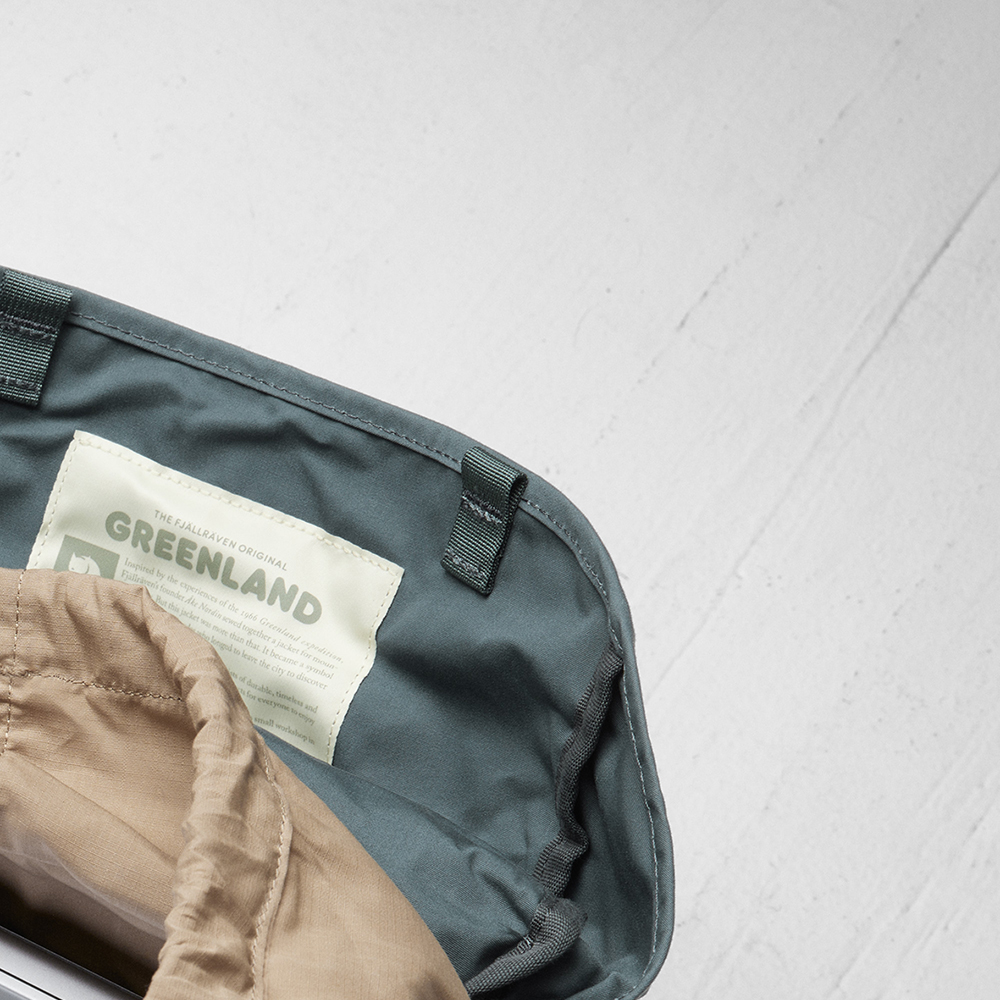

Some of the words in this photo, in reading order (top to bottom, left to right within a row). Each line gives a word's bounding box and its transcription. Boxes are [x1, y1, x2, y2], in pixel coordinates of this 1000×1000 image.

[105, 511, 322, 625] GREENLAND
[154, 509, 173, 525] THE
[175, 518, 237, 549] FJÄLLRÄVEN
[237, 544, 287, 572] ORIGINAL
[124, 558, 154, 575] Inspired
[155, 569, 166, 581] by
[166, 574, 179, 585] the
[179, 579, 218, 604] experiences
[218, 599, 230, 608] of
[227, 602, 240, 614] the
[240, 610, 258, 622] 1966
[259, 617, 302, 642] Greenland
[158, 583, 186, 602] founder
[221, 615, 244, 630] sewed
[241, 624, 272, 642] together
[274, 638, 300, 655] jacket
[299, 649, 313, 660] for
[156, 595, 168, 607] But
[167, 601, 180, 614] this
[178, 607, 200, 623] jacket
[200, 618, 212, 629] was
[211, 624, 229, 638] more
[228, 631, 245, 645] than
[245, 638, 261, 652] that.
[268, 648, 299, 666] became
[305, 664, 335, 680] symbol
[240, 649, 258, 665] leave
[257, 658, 271, 671] the
[269, 664, 286, 679] city
[295, 671, 328, 690] discover
[246, 690, 258, 701] for
[258, 698, 290, 710] everyone
[254, 717, 274, 727] small
[275, 691, 303, 705] timeless
[303, 703, 319, 715] and
